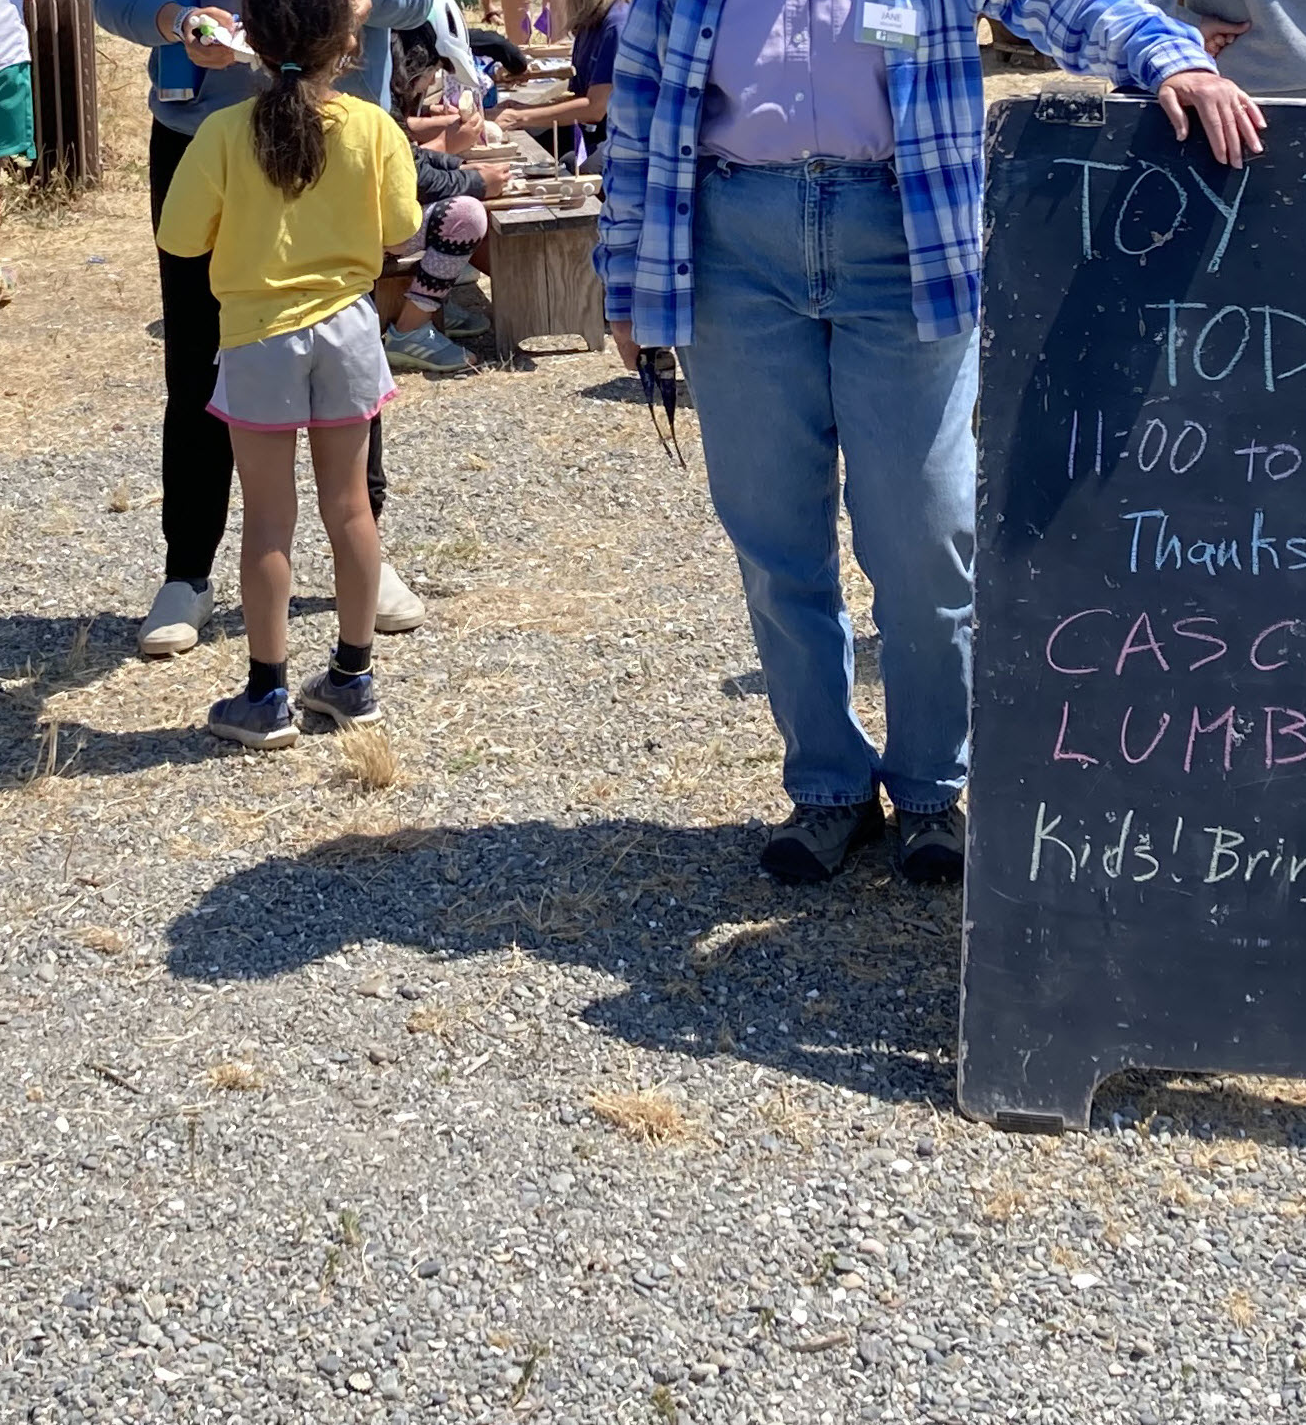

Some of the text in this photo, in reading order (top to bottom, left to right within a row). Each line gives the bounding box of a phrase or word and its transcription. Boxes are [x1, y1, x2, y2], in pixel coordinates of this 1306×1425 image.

[1054, 159, 1251, 274] TOY
[1067, 410, 1207, 480] 11:00
[1234, 437, 1302, 483] to
[1029, 802, 1183, 883] Kids!
